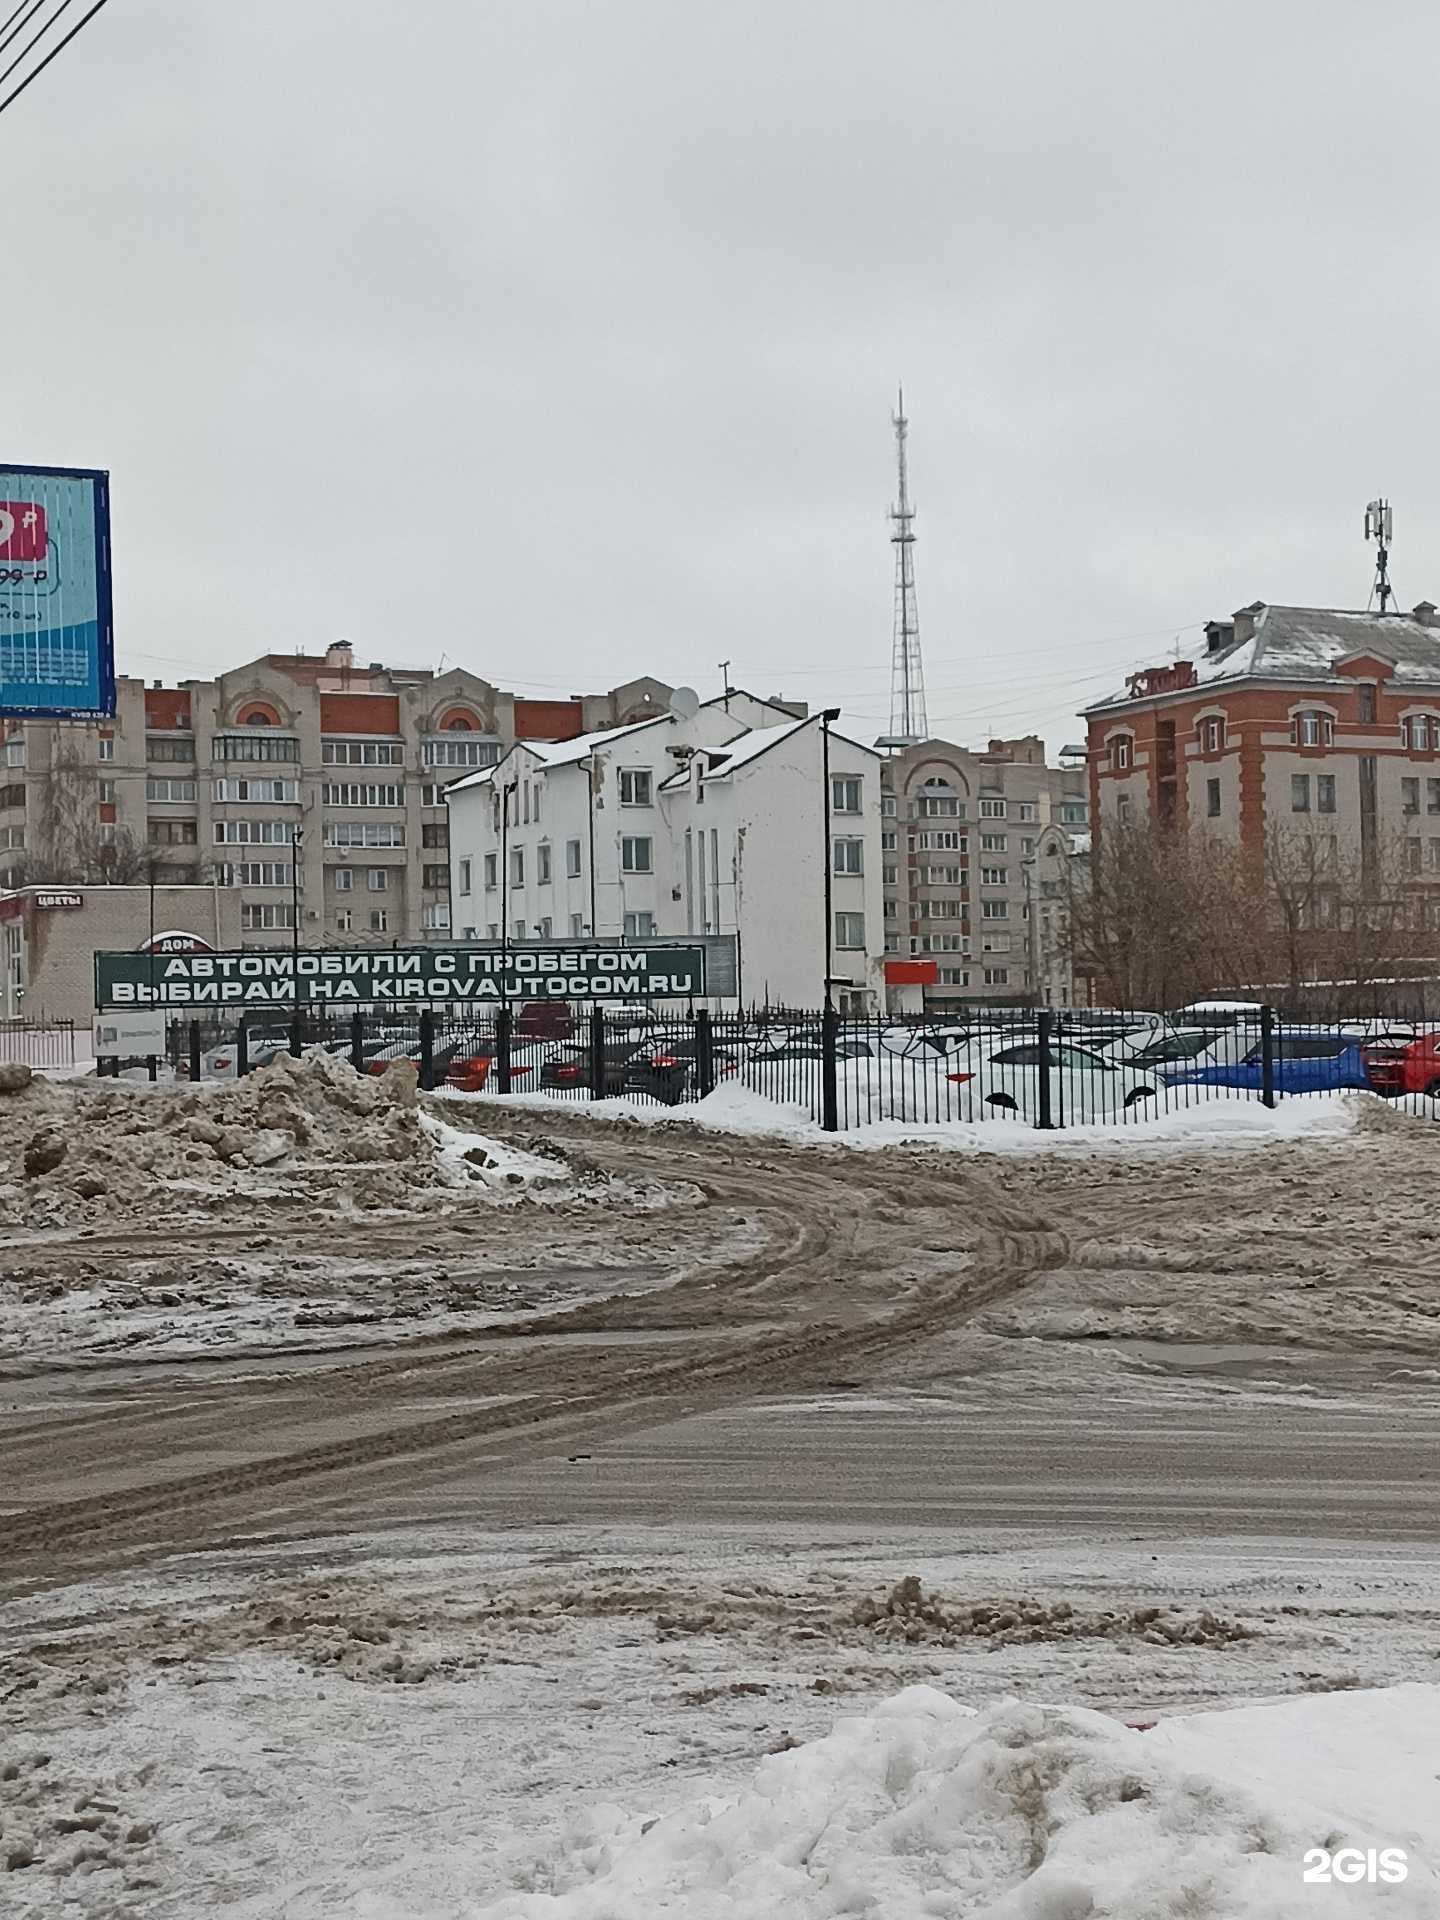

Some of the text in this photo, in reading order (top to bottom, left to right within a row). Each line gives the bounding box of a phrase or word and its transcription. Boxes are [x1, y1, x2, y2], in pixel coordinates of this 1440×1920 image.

[38, 896, 81, 906] ЦВЕТЫ
[161, 939, 195, 952] ДОМ
[164, 953, 647, 977] АВТОМОБИЛИ С ПРОБЕГОМ
[111, 974, 692, 1002] ВЫБИРАЙ НА KIROVAUTOCOM.RU
